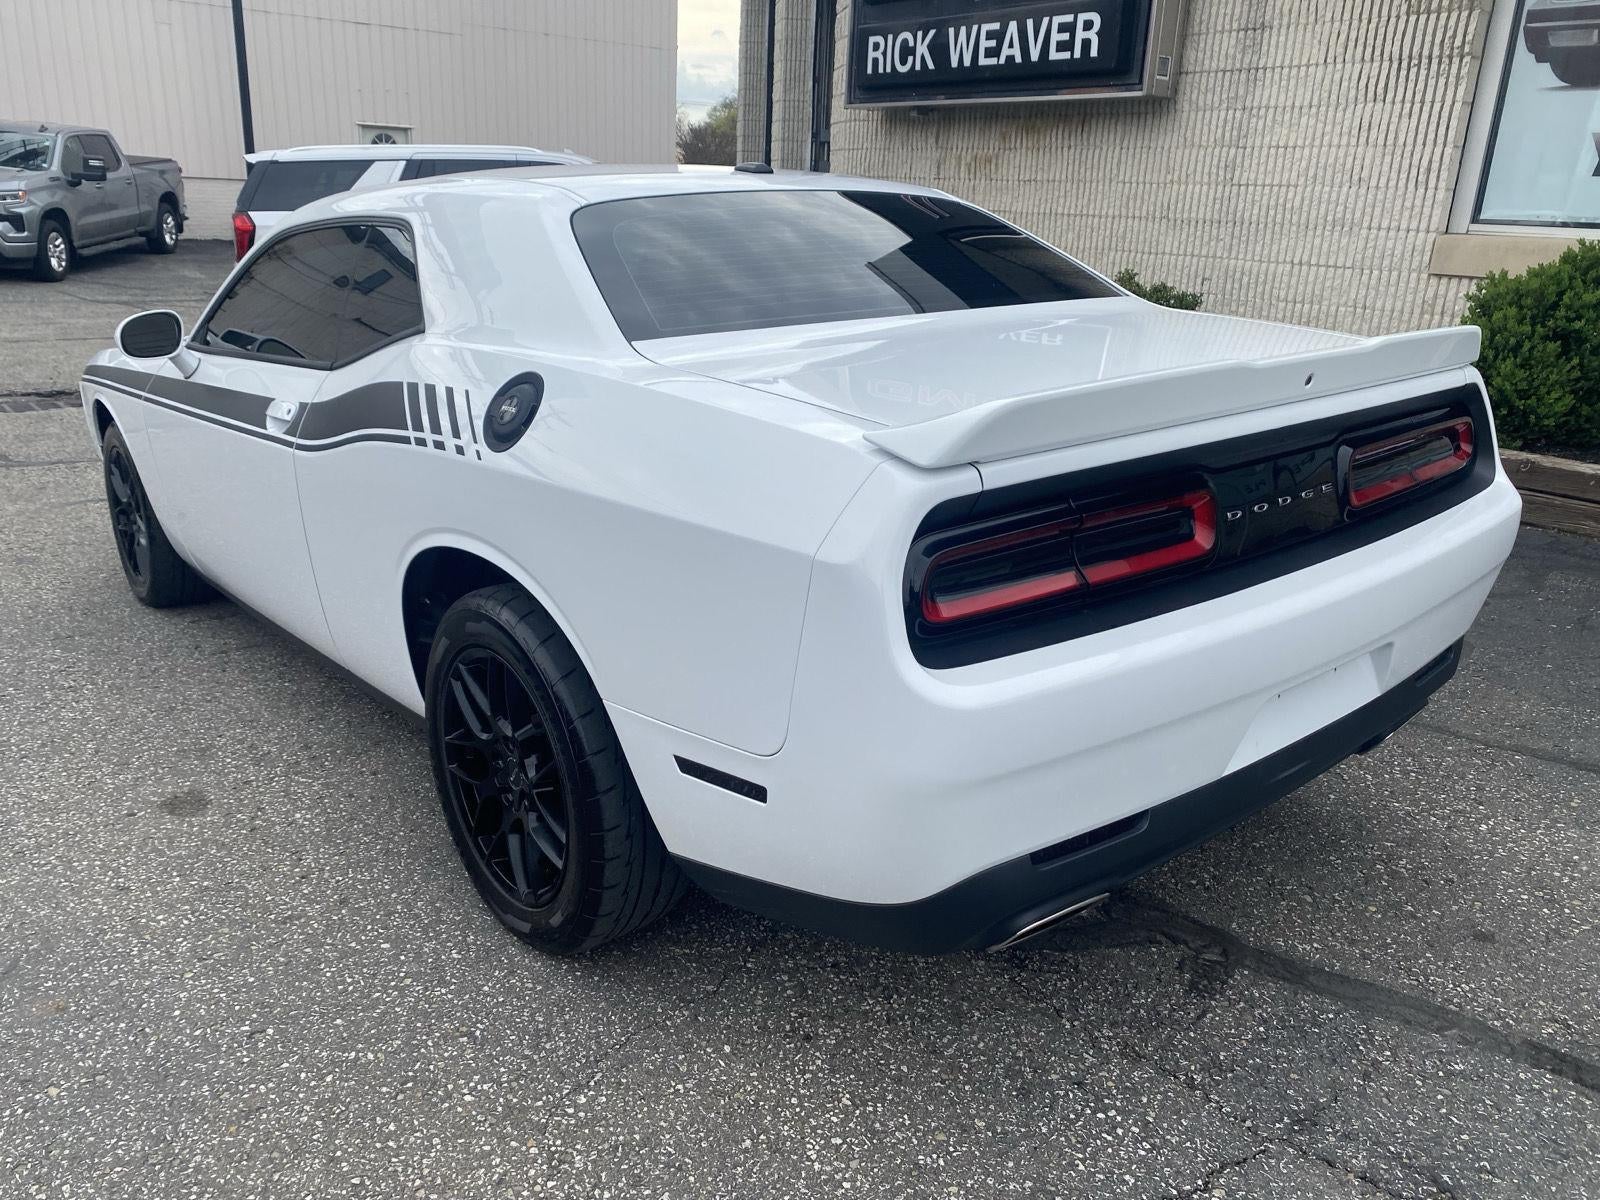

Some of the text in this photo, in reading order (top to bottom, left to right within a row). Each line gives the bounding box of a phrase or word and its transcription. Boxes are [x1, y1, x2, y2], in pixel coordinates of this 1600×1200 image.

[866, 11, 1102, 74] RICK WEAVER
[1227, 483, 1333, 521] DODGE
